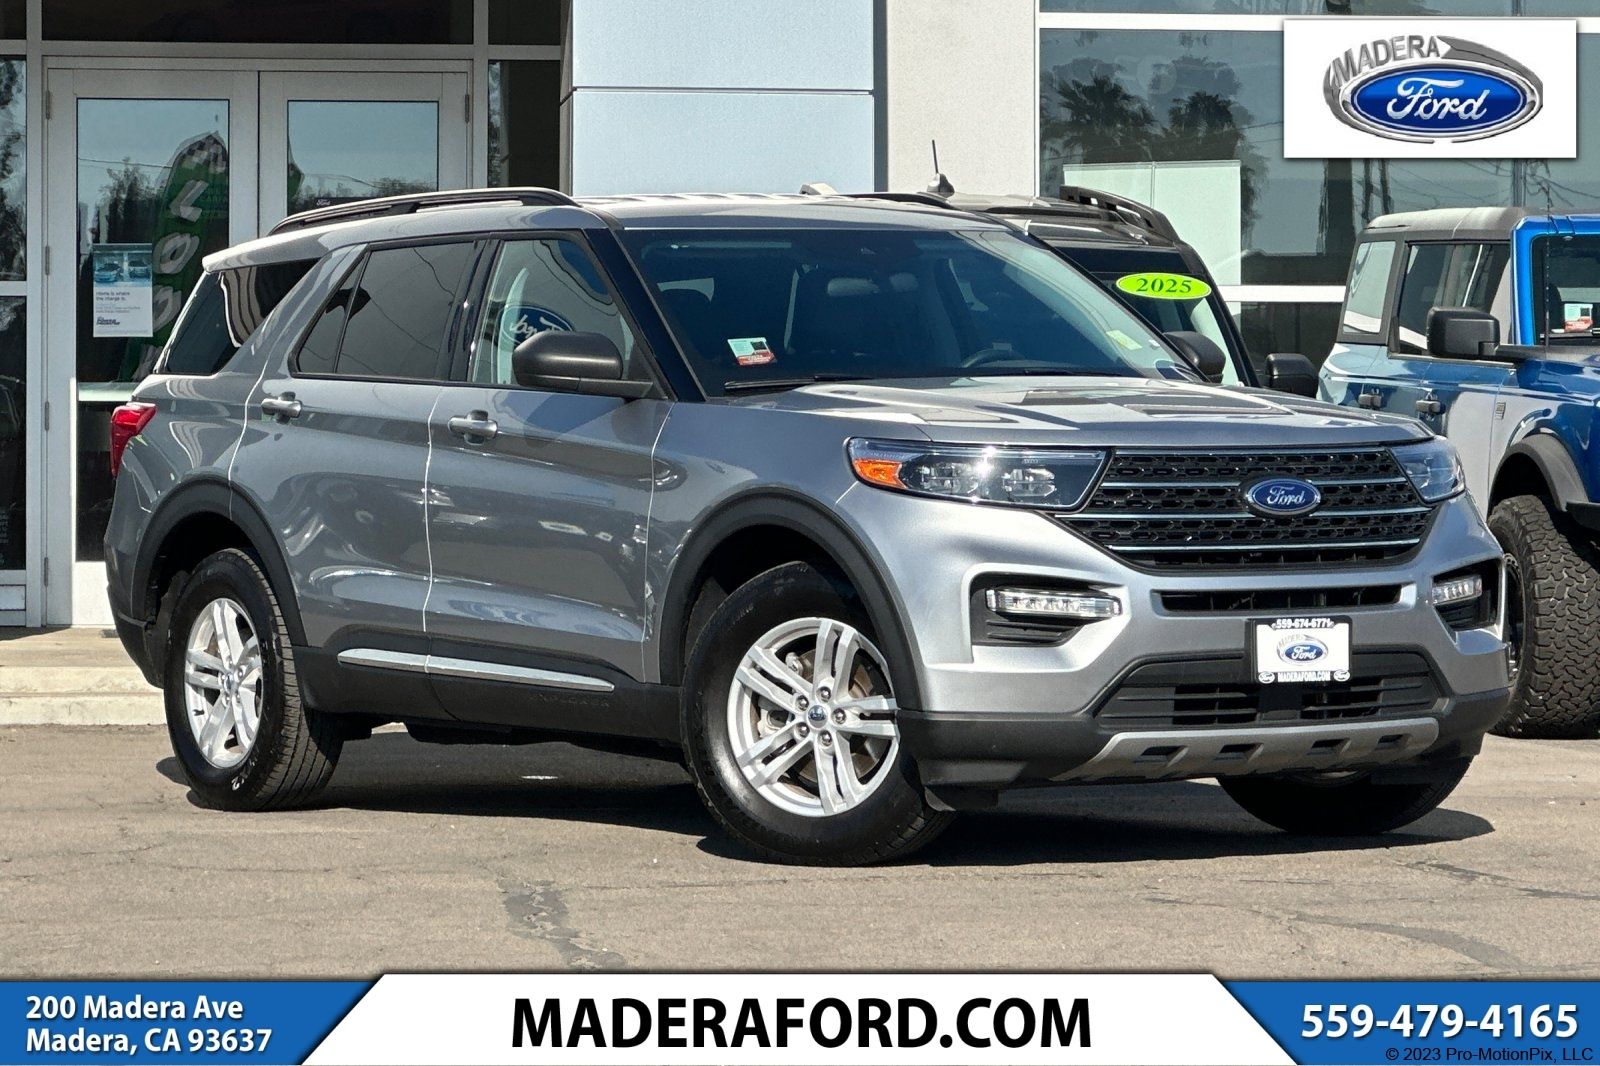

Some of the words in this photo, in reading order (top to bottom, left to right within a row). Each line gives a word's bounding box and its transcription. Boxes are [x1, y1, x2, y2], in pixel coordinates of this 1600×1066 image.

[1136, 277, 1192, 294] 2025
[1266, 485, 1305, 506] Ford
[1291, 646, 1317, 660] Ford
